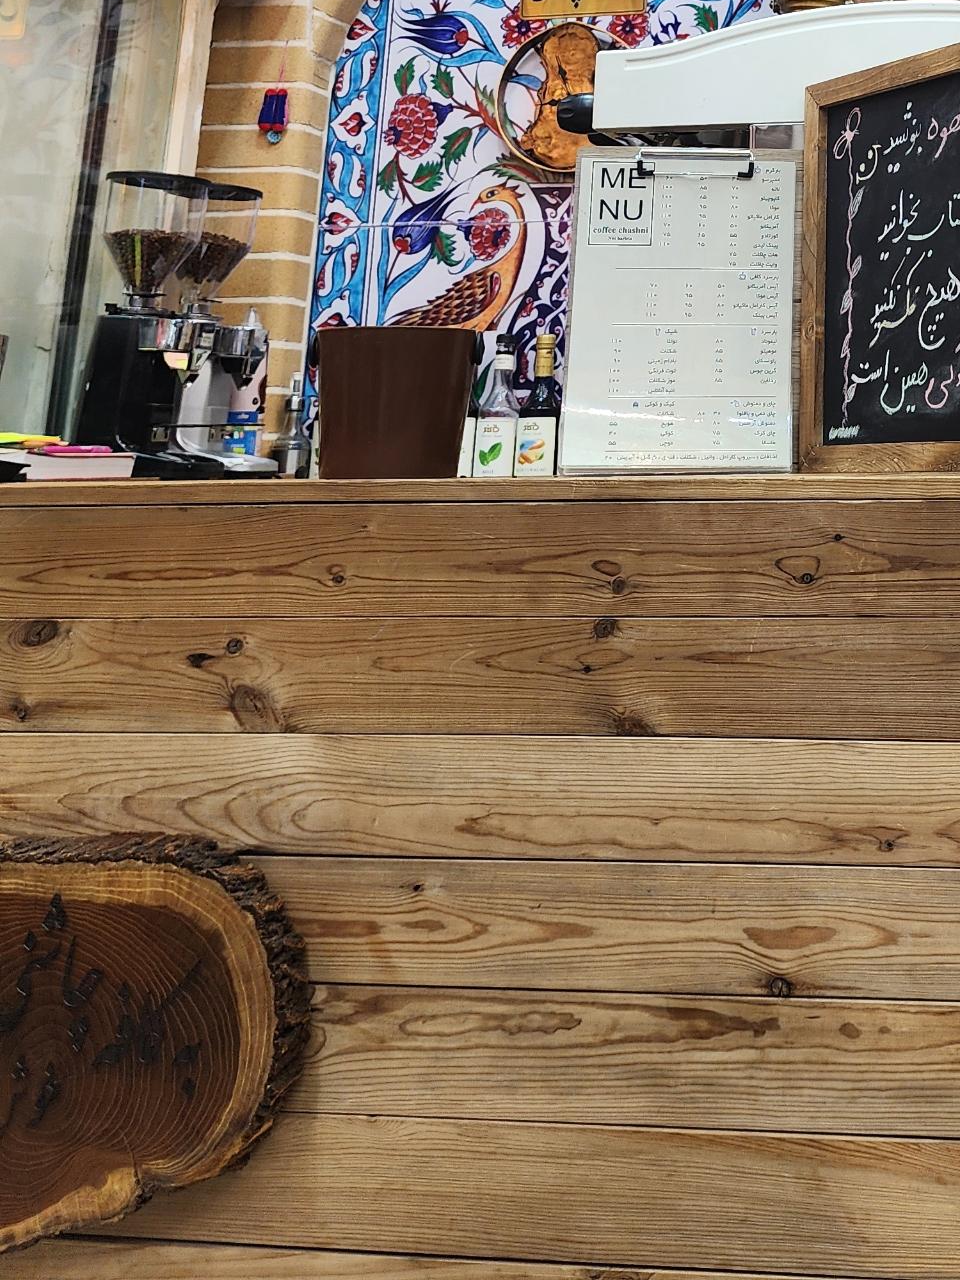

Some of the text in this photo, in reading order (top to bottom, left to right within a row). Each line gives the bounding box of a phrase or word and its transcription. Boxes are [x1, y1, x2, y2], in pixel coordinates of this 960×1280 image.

[601, 168, 647, 189] ME
[600, 199, 643, 221] NU
[851, 349, 890, 384] است
[92, 958, 203, 1068] کافه
